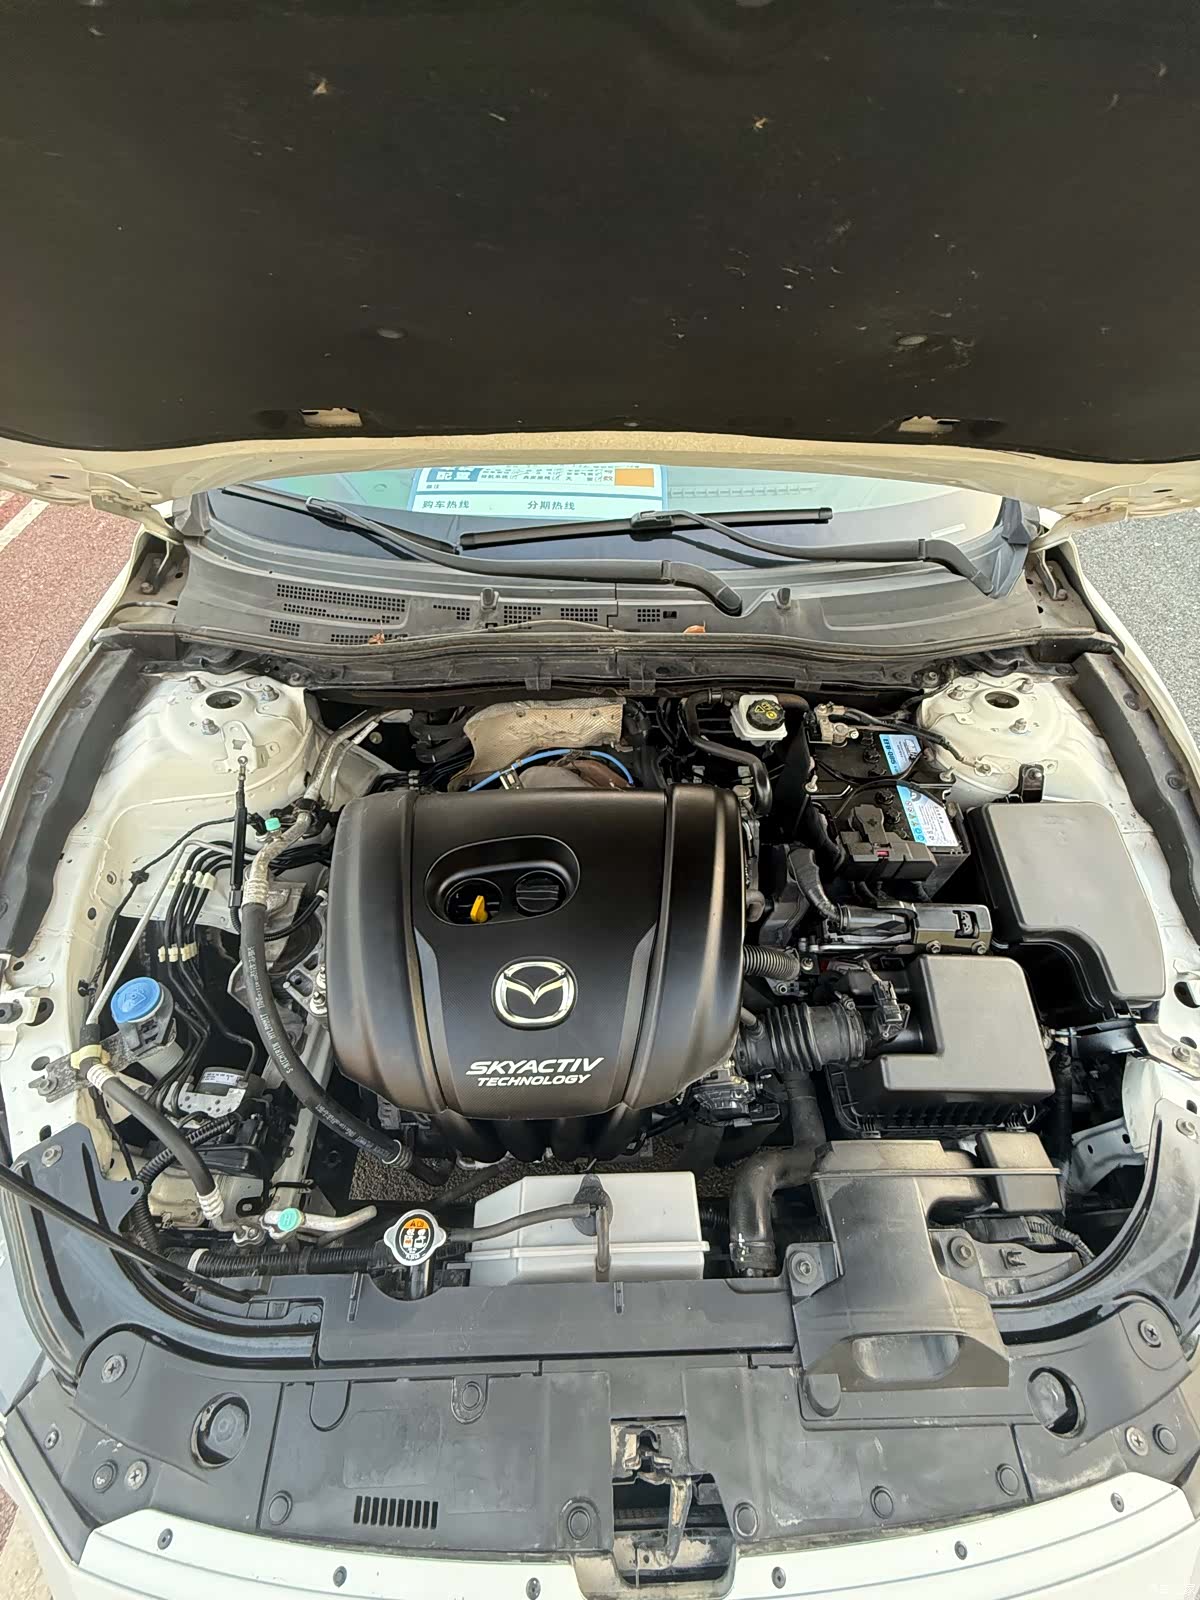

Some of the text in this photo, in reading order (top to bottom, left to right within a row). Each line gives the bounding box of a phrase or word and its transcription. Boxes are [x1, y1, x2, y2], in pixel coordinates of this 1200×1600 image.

[422, 500, 470, 509] 购车热线
[527, 500, 575, 510] 分期热线
[465, 1057, 604, 1075] SKYACTIV
[477, 1074, 591, 1087] TECHNOLOGY
